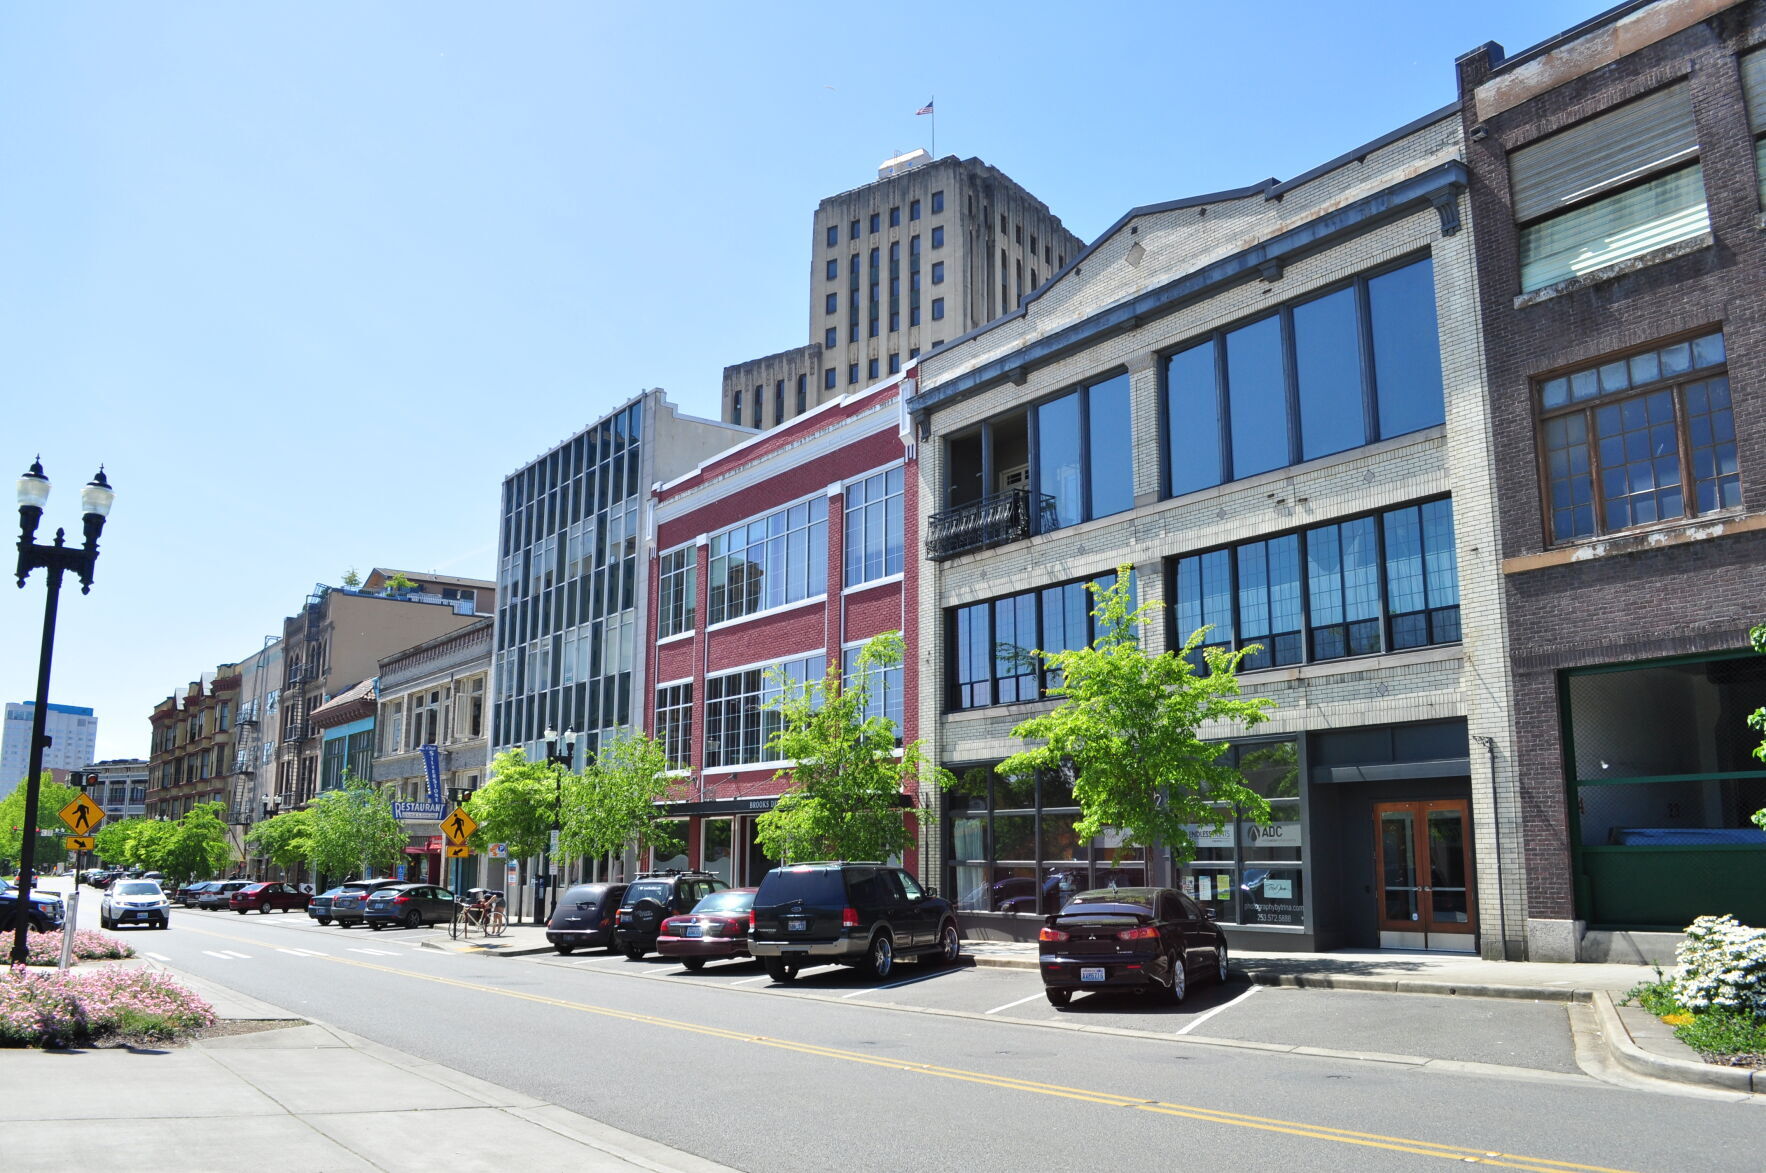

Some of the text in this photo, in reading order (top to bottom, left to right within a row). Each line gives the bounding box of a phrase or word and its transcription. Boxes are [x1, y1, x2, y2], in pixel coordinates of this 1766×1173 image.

[395, 802, 445, 819] RESTAURANT
[749, 801, 769, 809] BROOKS
[1262, 825, 1283, 838] ADC
